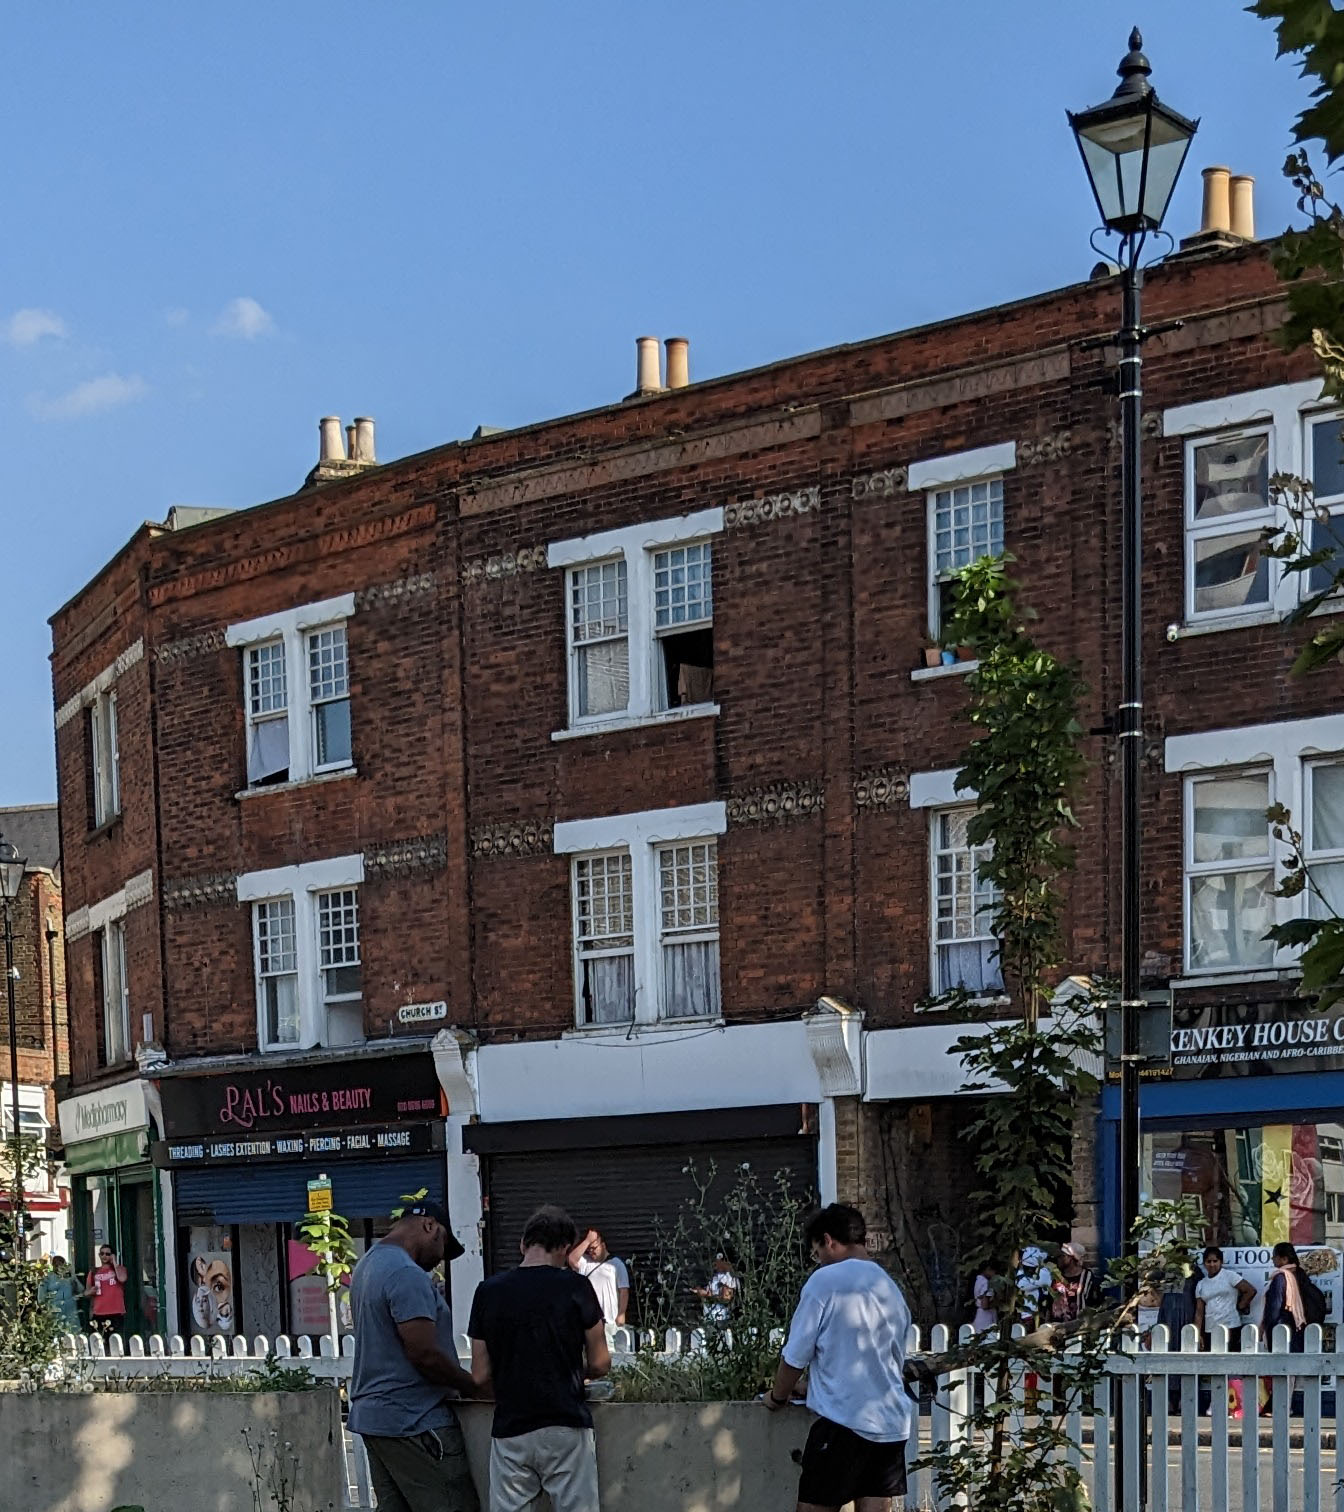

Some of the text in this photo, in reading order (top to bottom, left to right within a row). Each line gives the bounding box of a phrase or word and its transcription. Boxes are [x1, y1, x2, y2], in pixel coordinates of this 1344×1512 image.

[401, 1007, 432, 1019] CHURCH
[1251, 1018, 1330, 1046] HOUSE
[1174, 1054, 1218, 1065] GHANAIAN,
[1219, 1050, 1260, 1062] NIGERIAN
[1261, 1049, 1279, 1059] AND
[289, 1093, 320, 1114] NAILS
[321, 1092, 329, 1112] &
[331, 1088, 372, 1112] BEAUTY
[168, 1132, 411, 1160] THREADING LASHES EXTENTION WAXING PIERCING FACIAL MASSAGE
[1234, 1249, 1272, 1265] FOO
